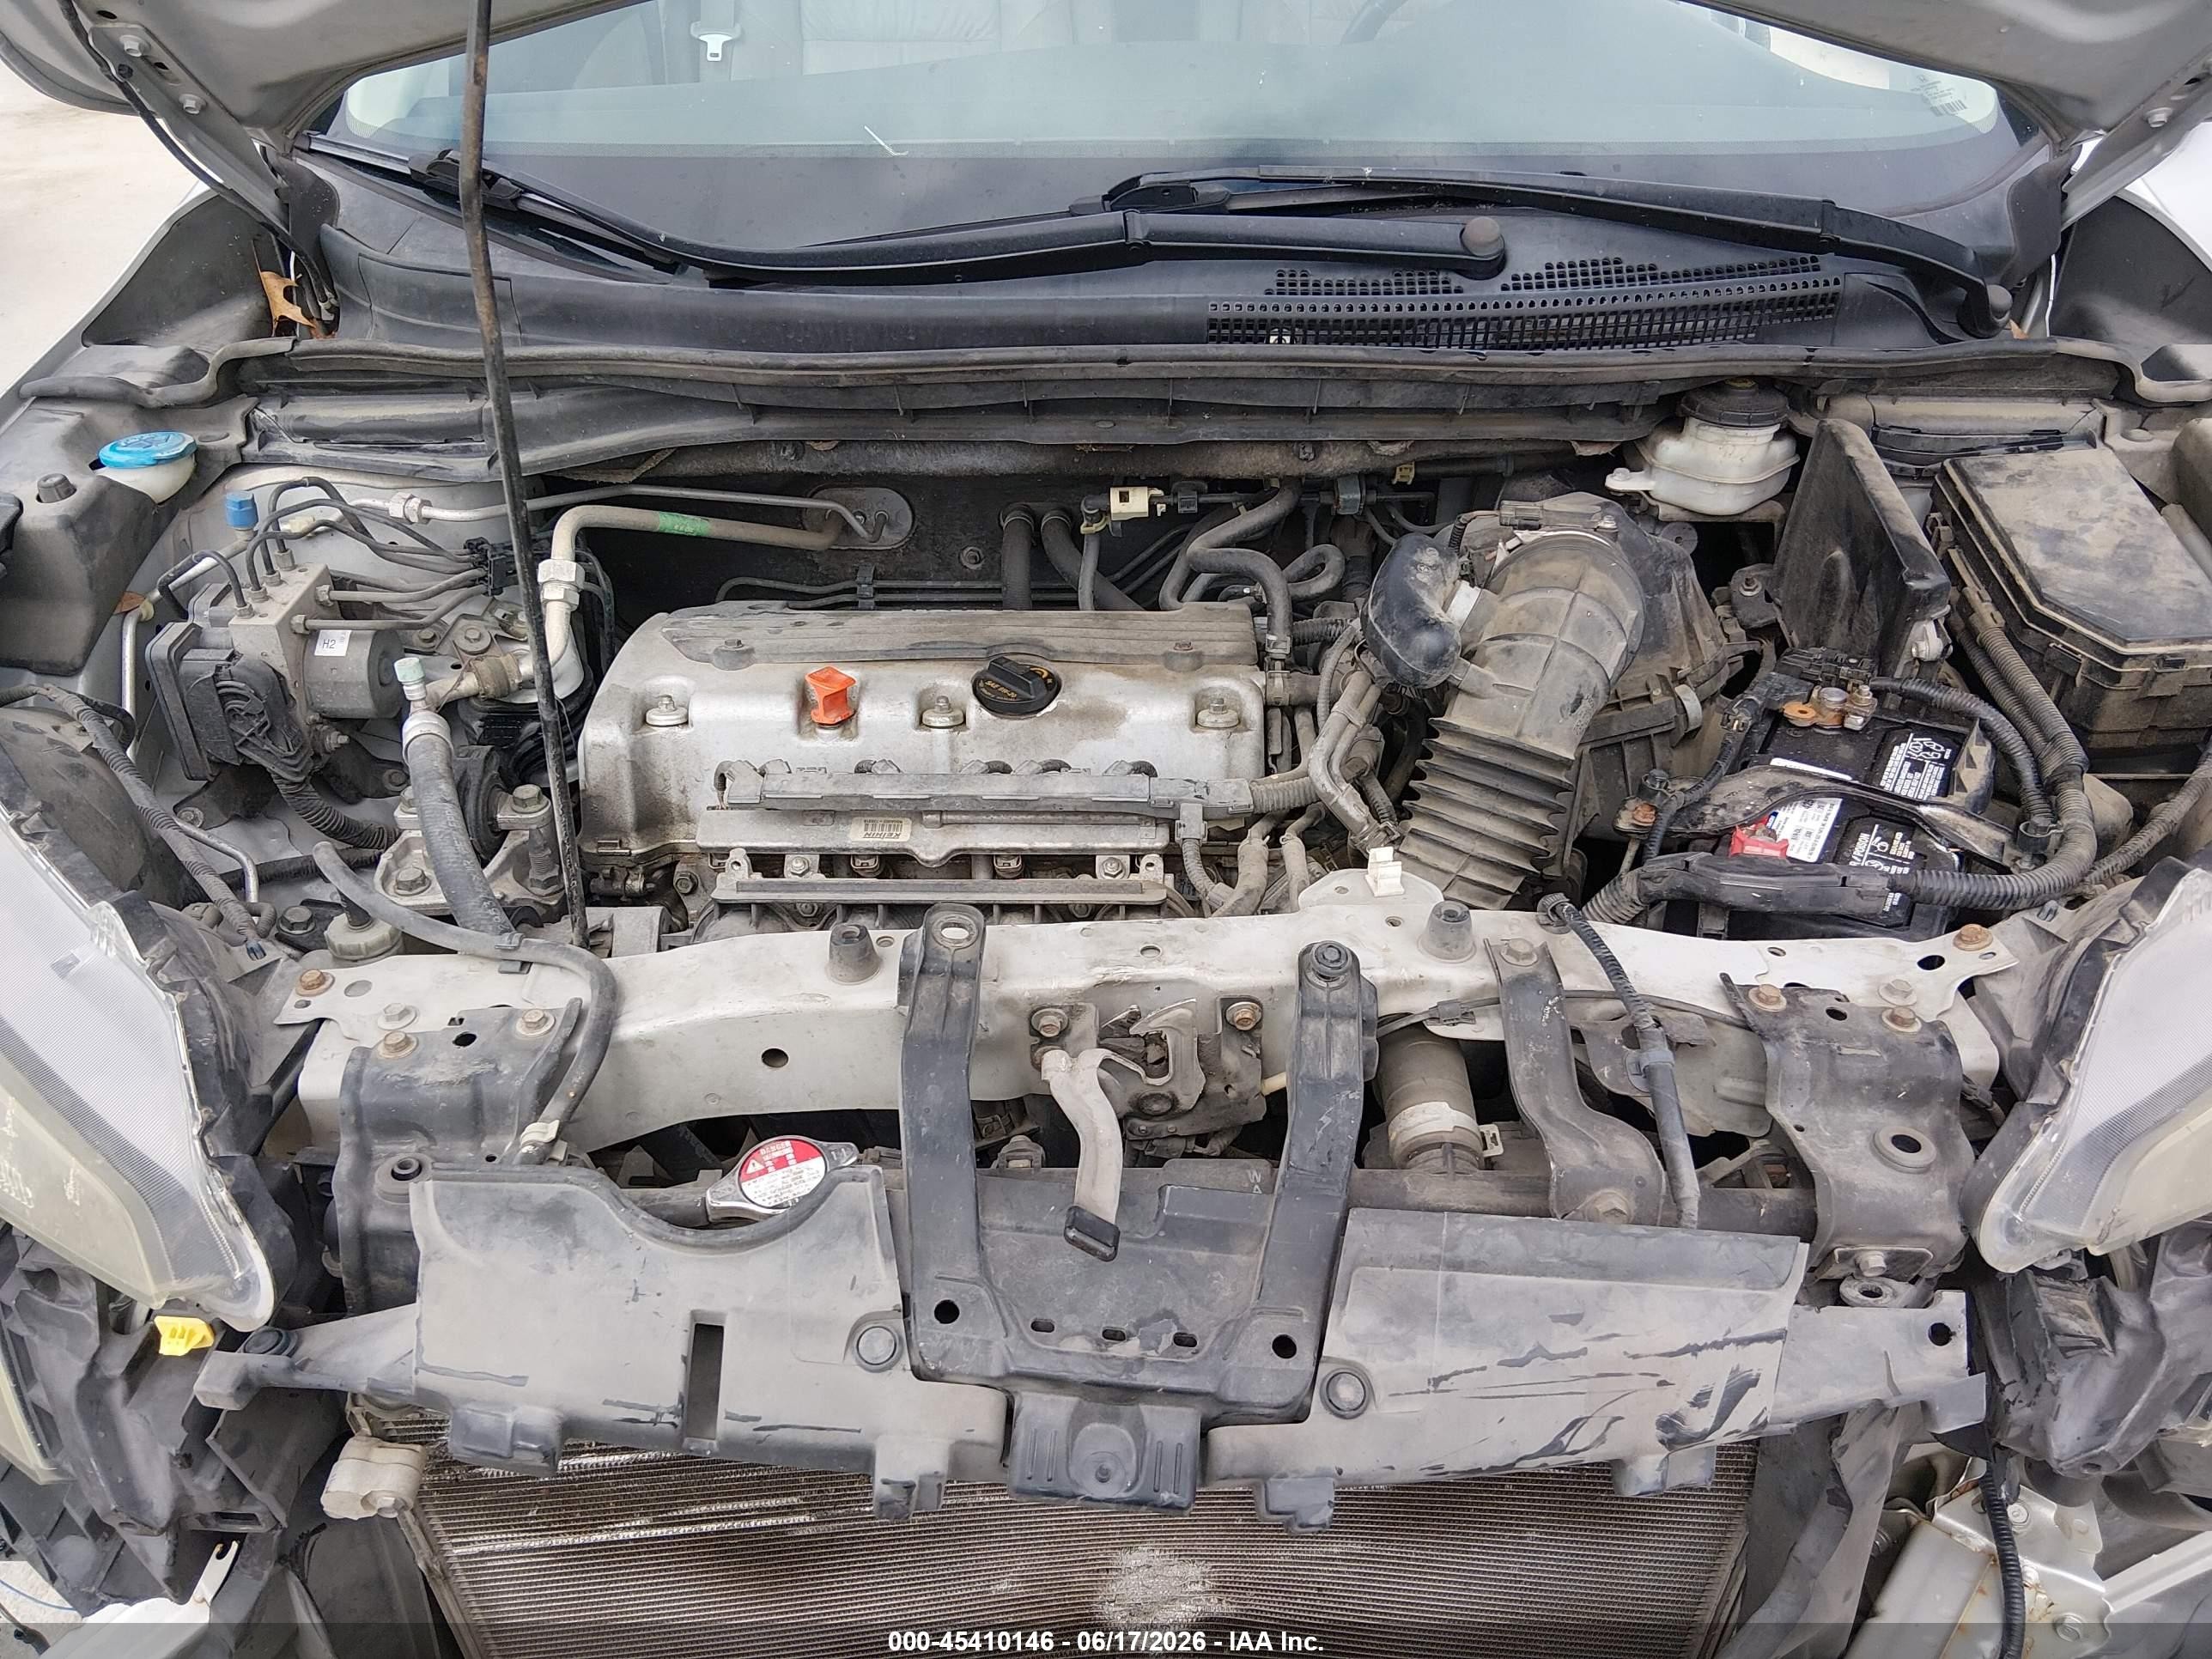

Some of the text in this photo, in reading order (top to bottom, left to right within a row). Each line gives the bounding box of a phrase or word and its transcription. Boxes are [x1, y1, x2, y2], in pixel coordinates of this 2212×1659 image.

[323, 639, 336, 648] H2
[984, 680, 1000, 689] SAE
[1852, 832, 1870, 857] POISON
[760, 1140, 791, 1155] DANGER
